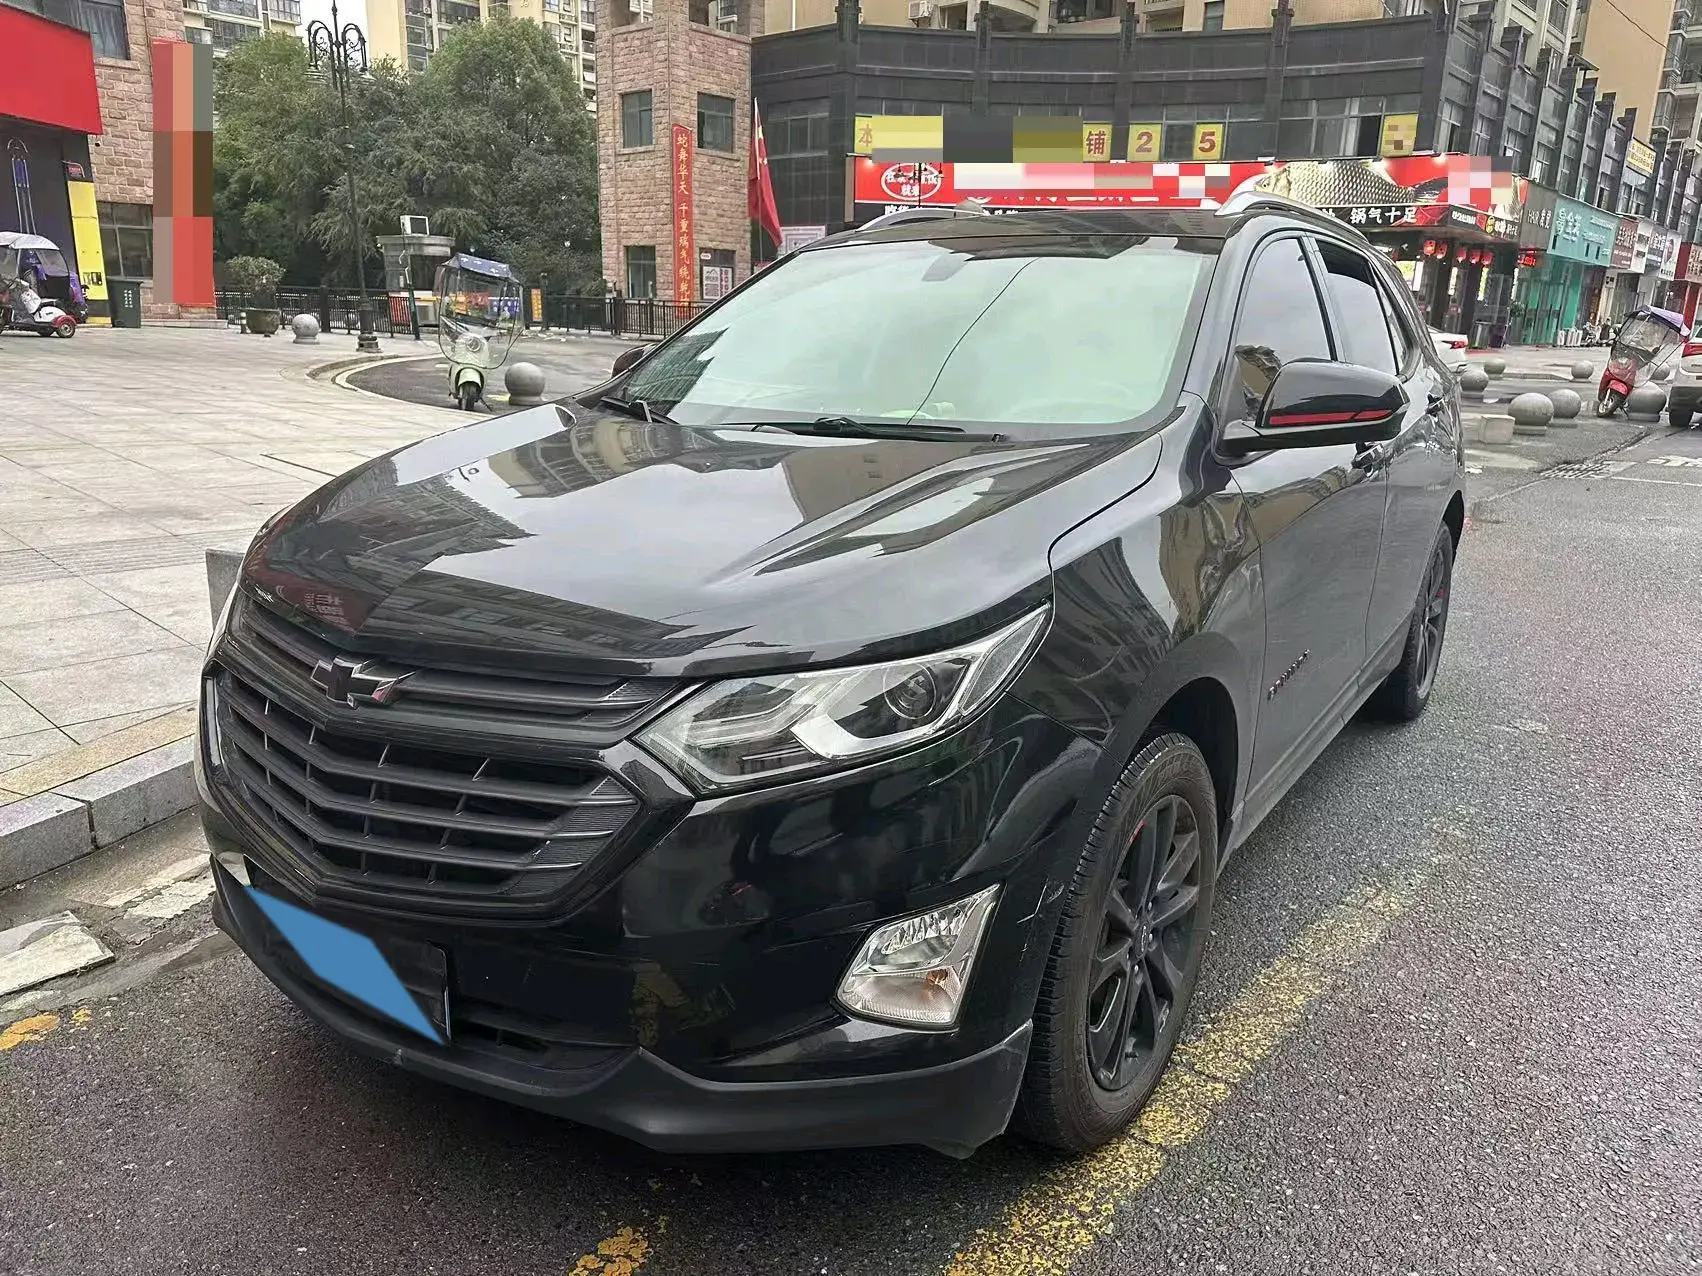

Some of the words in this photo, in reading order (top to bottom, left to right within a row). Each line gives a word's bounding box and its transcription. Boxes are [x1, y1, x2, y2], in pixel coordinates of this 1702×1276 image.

[1086, 130, 1106, 155] 铺
[1136, 131, 1154, 153] 2
[1198, 131, 1217, 153] 5
[1350, 206, 1416, 224] 锅气十足
